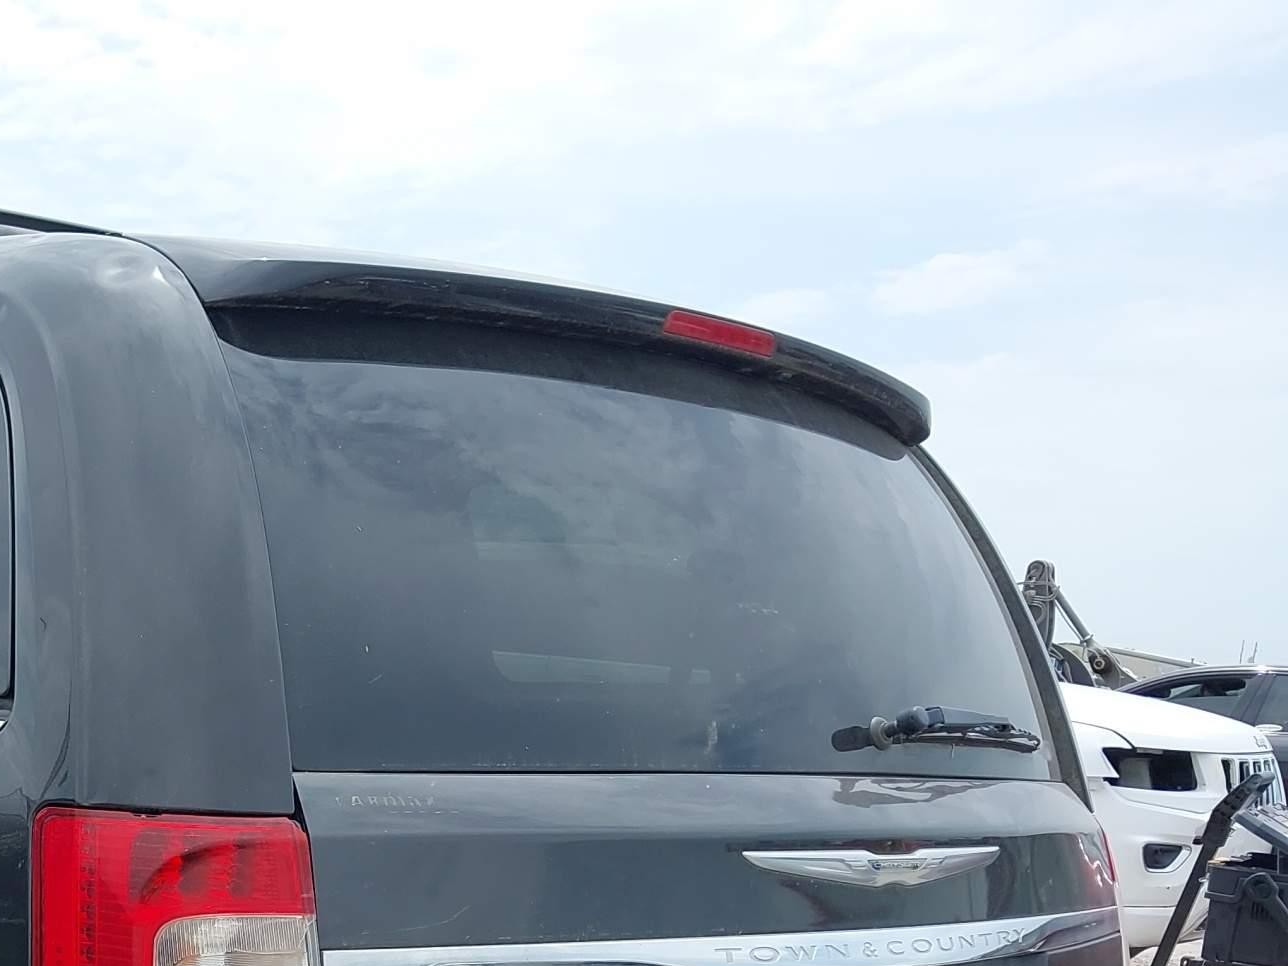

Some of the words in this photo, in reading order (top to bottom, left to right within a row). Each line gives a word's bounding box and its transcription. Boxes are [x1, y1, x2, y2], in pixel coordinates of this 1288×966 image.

[713, 943, 850, 963] TOWN
[862, 941, 879, 959] &
[886, 927, 1026, 956] COUNTRY
